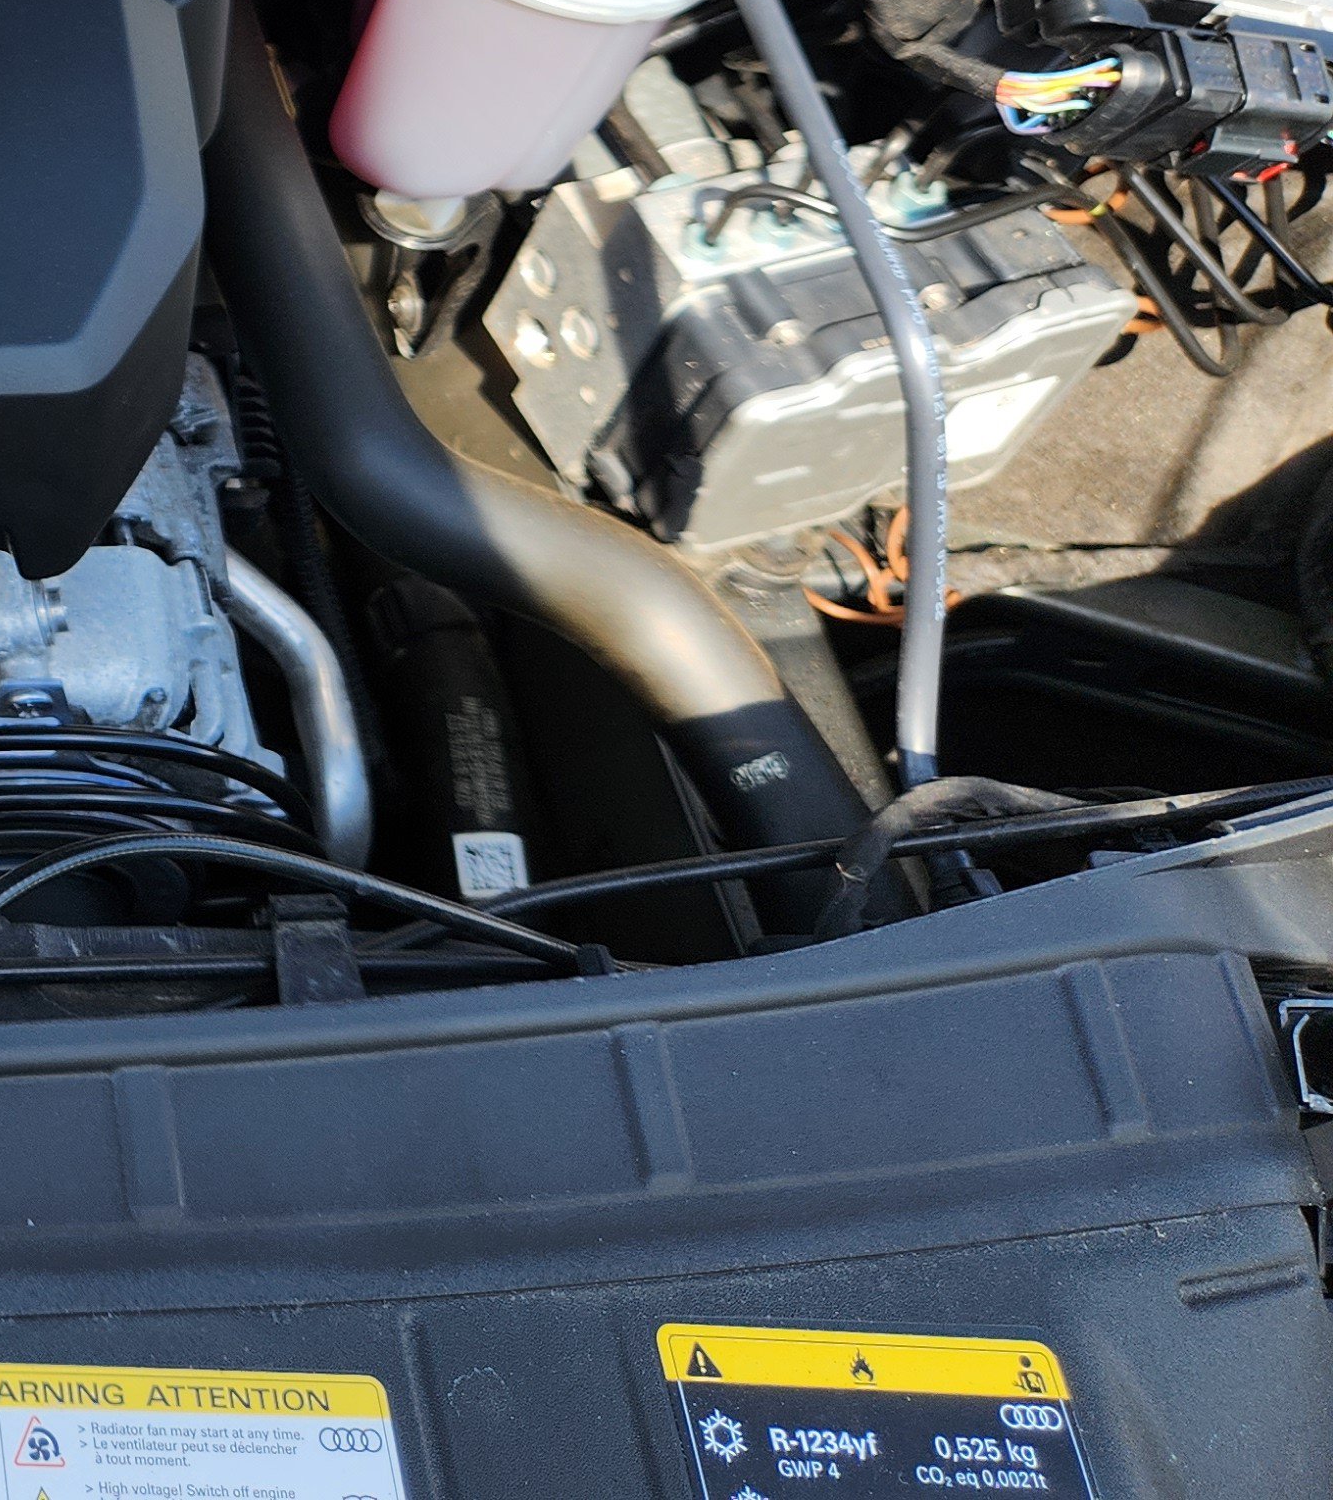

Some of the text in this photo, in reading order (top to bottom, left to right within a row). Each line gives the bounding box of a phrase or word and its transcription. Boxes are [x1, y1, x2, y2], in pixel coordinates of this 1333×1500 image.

[146, 1384, 331, 1412] ATTENTION
[91, 1422, 305, 1441] Radiator fan may start at any time.
[93, 1437, 297, 1455] Le ventilateur peut se déclencher
[768, 1427, 879, 1460] R-1234yf
[935, 1435, 1038, 1468] 0,525 kg
[95, 1452, 191, 1467] à tout moment.
[778, 1460, 841, 1480] GWP 4
[956, 1471, 980, 1489] eq
[99, 1481, 296, 1500] High voltage! Switch off engine
